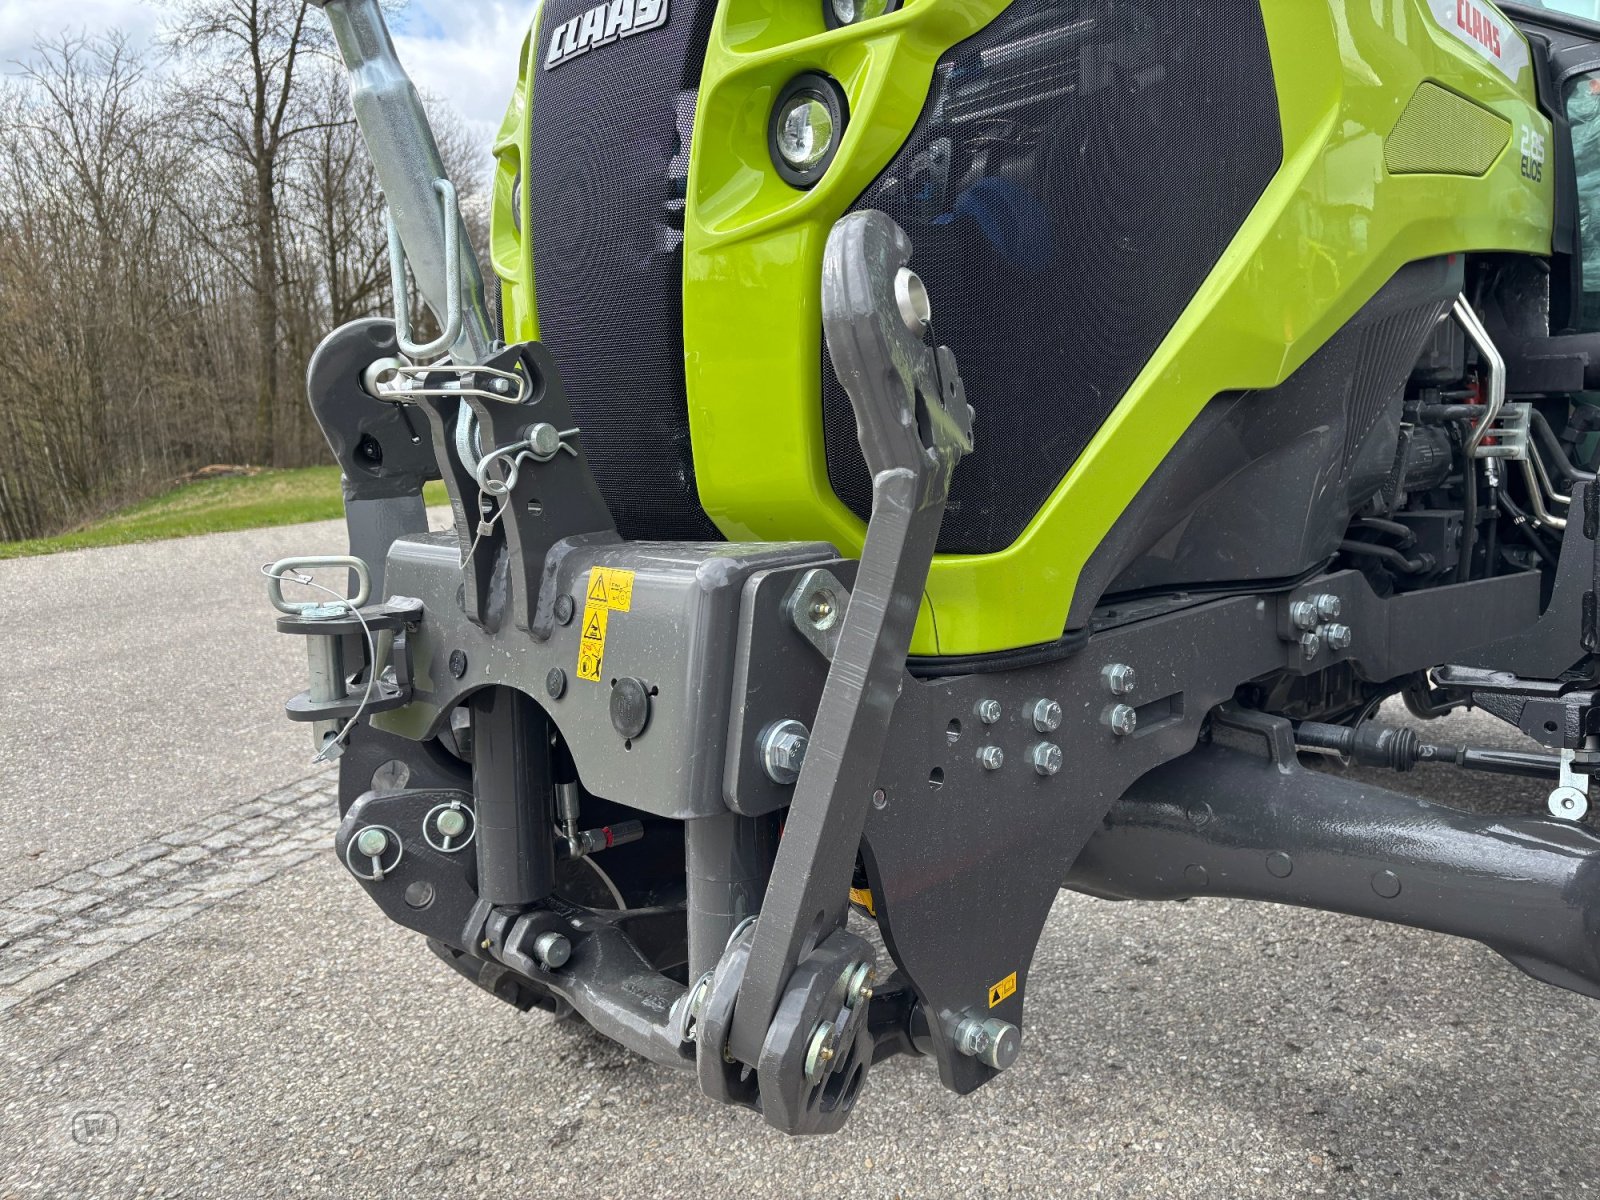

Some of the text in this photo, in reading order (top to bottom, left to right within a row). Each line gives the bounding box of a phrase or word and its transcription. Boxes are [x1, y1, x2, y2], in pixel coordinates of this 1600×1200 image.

[546, 0, 665, 65] CLAAS
[1456, 0, 1501, 59] CLAAS
[1521, 154, 1542, 184] ELIOS
